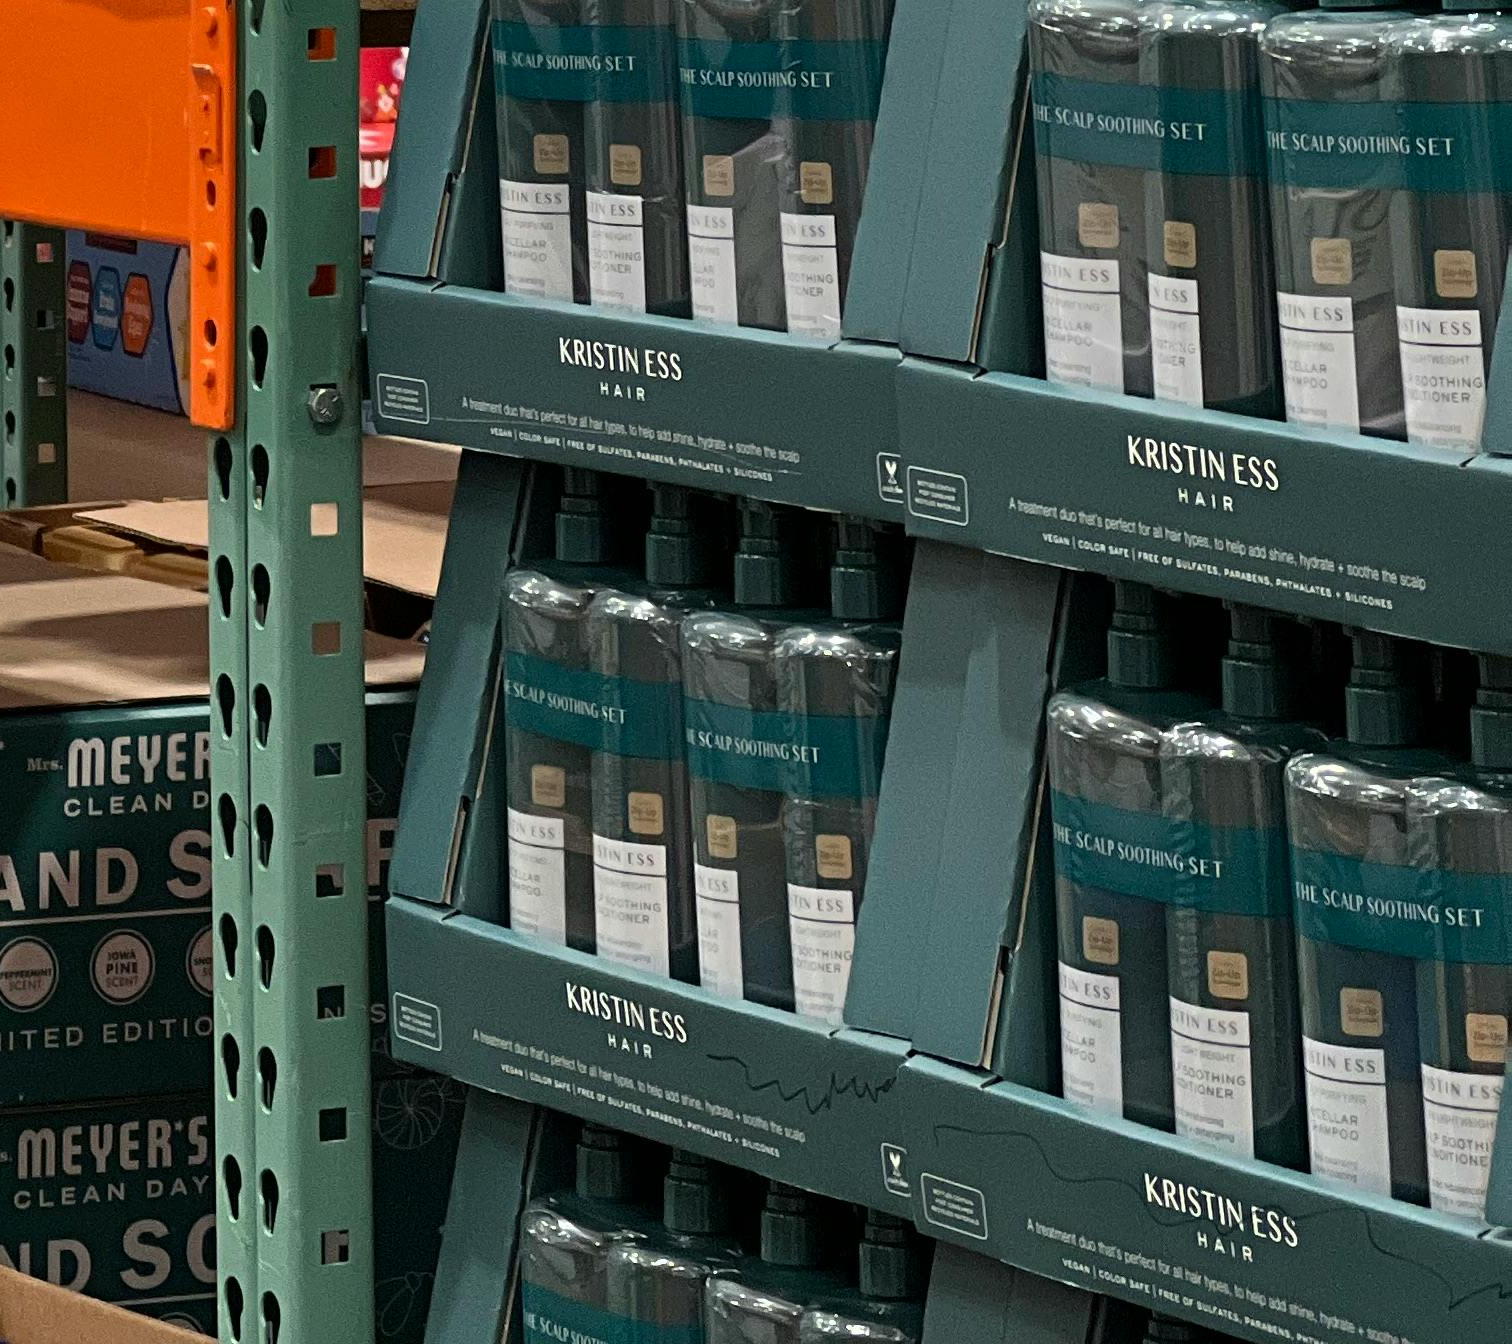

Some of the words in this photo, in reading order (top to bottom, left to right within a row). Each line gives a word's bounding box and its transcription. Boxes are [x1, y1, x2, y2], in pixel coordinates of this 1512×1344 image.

[1267, 130, 1288, 151] THE
[1292, 132, 1335, 154] SCALP
[1338, 135, 1410, 156] SOOTHING
[1416, 137, 1454, 156] SET
[1127, 435, 1226, 482] KRISTIN
[1233, 453, 1279, 491] ESS
[1178, 488, 1234, 512] HAIR
[1009, 497, 1016, 510] A
[1018, 500, 1057, 519] treatment
[1060, 510, 1077, 522] duo
[1079, 511, 1102, 528] that's
[1105, 517, 1136, 535] perfect
[1138, 522, 1150, 536] for
[1153, 526, 1163, 539] all
[1165, 527, 1181, 542] hair
[1184, 531, 1212, 550] types,
[1214, 538, 1223, 551] to
[1226, 538, 1246, 557] help
[1248, 545, 1266, 559] add
[1269, 547, 1296, 565] shine,
[1299, 552, 1334, 572] hydrate
[1347, 564, 1379, 581] soothe
[1382, 569, 1397, 584] the
[1400, 573, 1426, 591] scalp
[1042, 533, 1070, 546] VEGAN
[1078, 540, 1106, 553] COLOR
[1109, 546, 1129, 558] SAFE
[1138, 551, 1159, 564] FREE
[1162, 557, 1173, 566] OF
[1176, 558, 1222, 576] SULFATES,
[1224, 568, 1273, 587] PARABENS,
[1276, 579, 1332, 598] PHTHALATES
[1345, 591, 1392, 610] SILICONES
[26, 757, 63, 773] Mrs.
